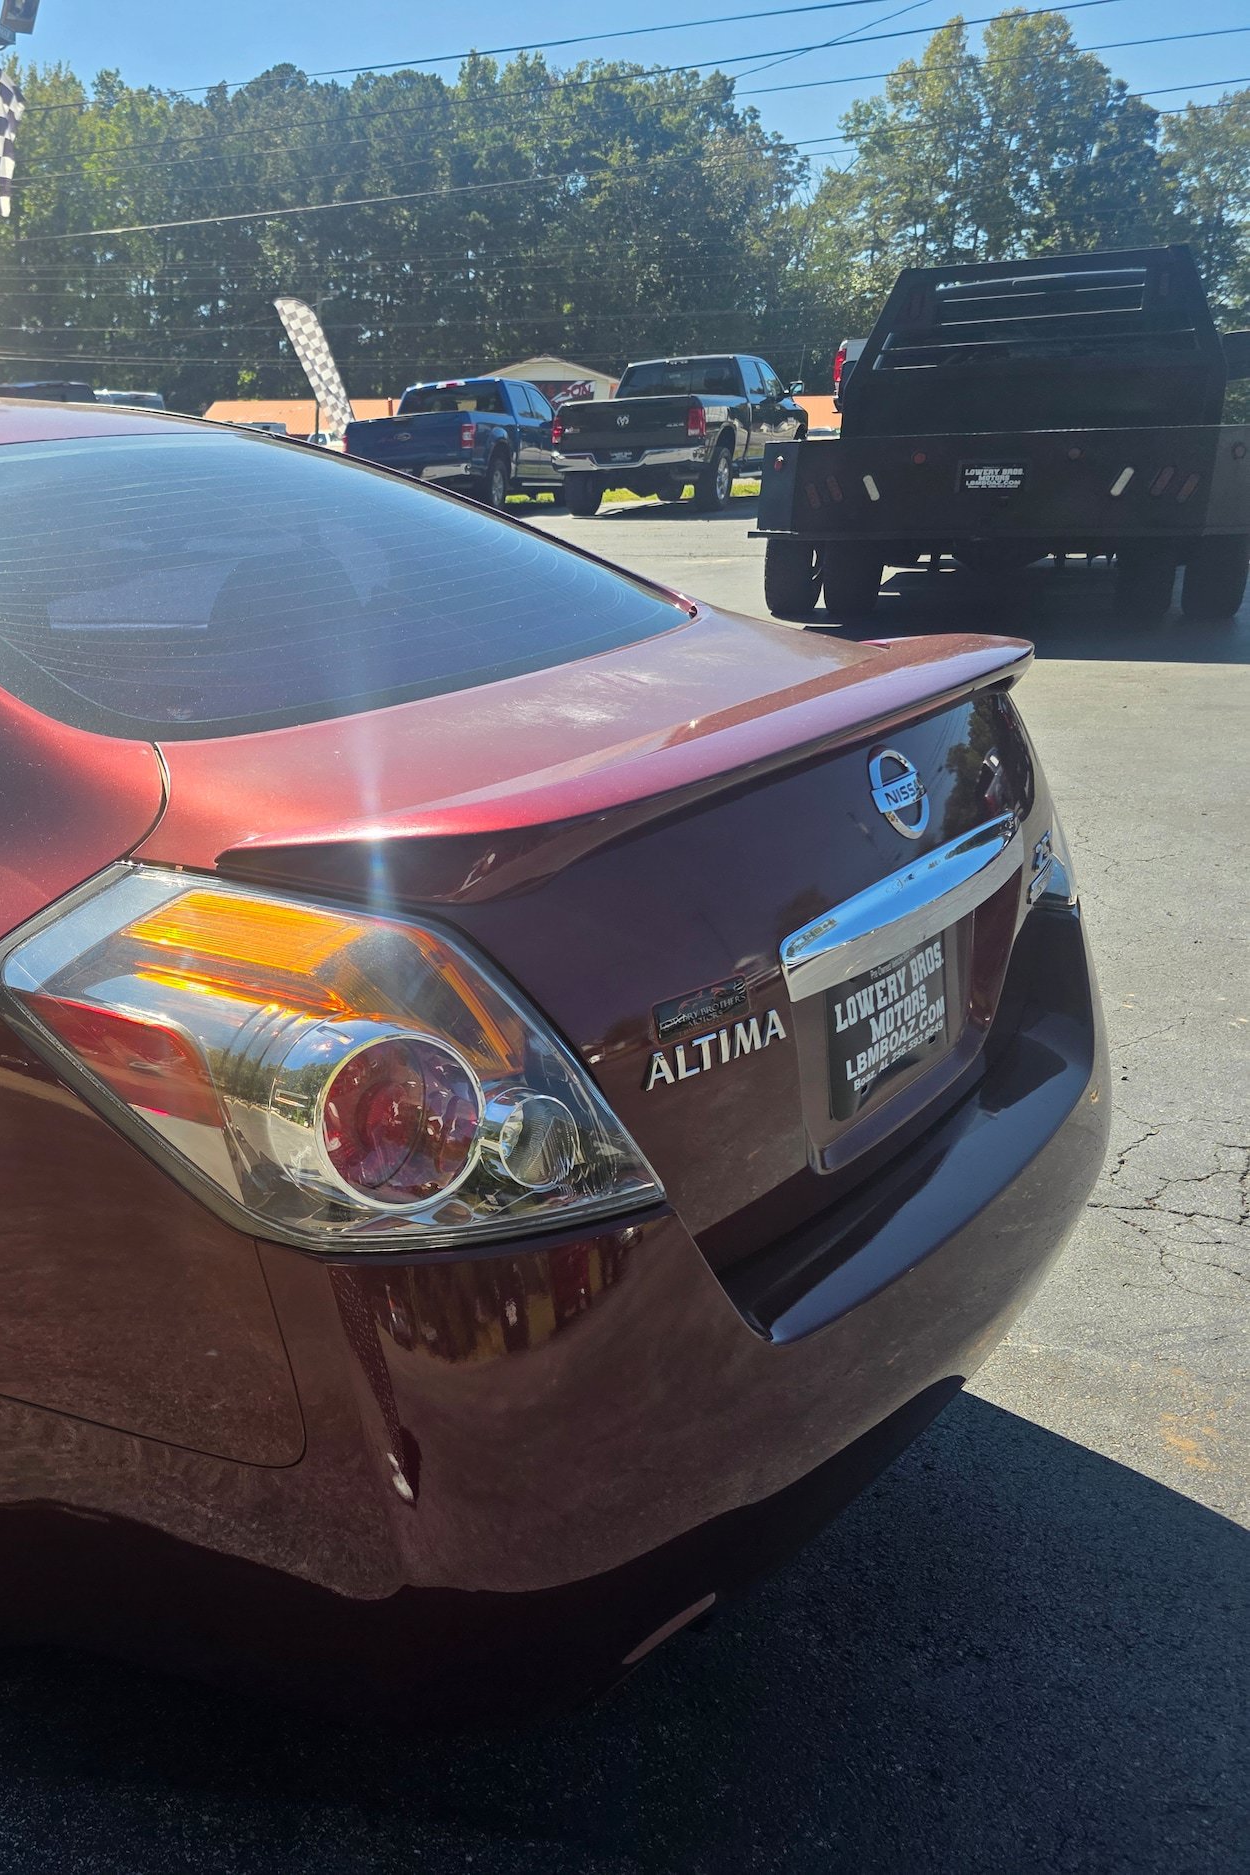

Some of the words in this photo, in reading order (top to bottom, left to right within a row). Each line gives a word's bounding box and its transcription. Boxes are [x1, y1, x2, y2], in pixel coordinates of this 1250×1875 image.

[700, 994, 746, 1016] BROTHERS
[834, 966, 907, 1034] LOWERY
[909, 941, 944, 987] BROS.
[869, 983, 927, 1043] MOTORS
[646, 1008, 787, 1092] ALTIMA
[845, 995, 945, 1081] LBMBOAZ.COM
[878, 1058, 890, 1073] AL
